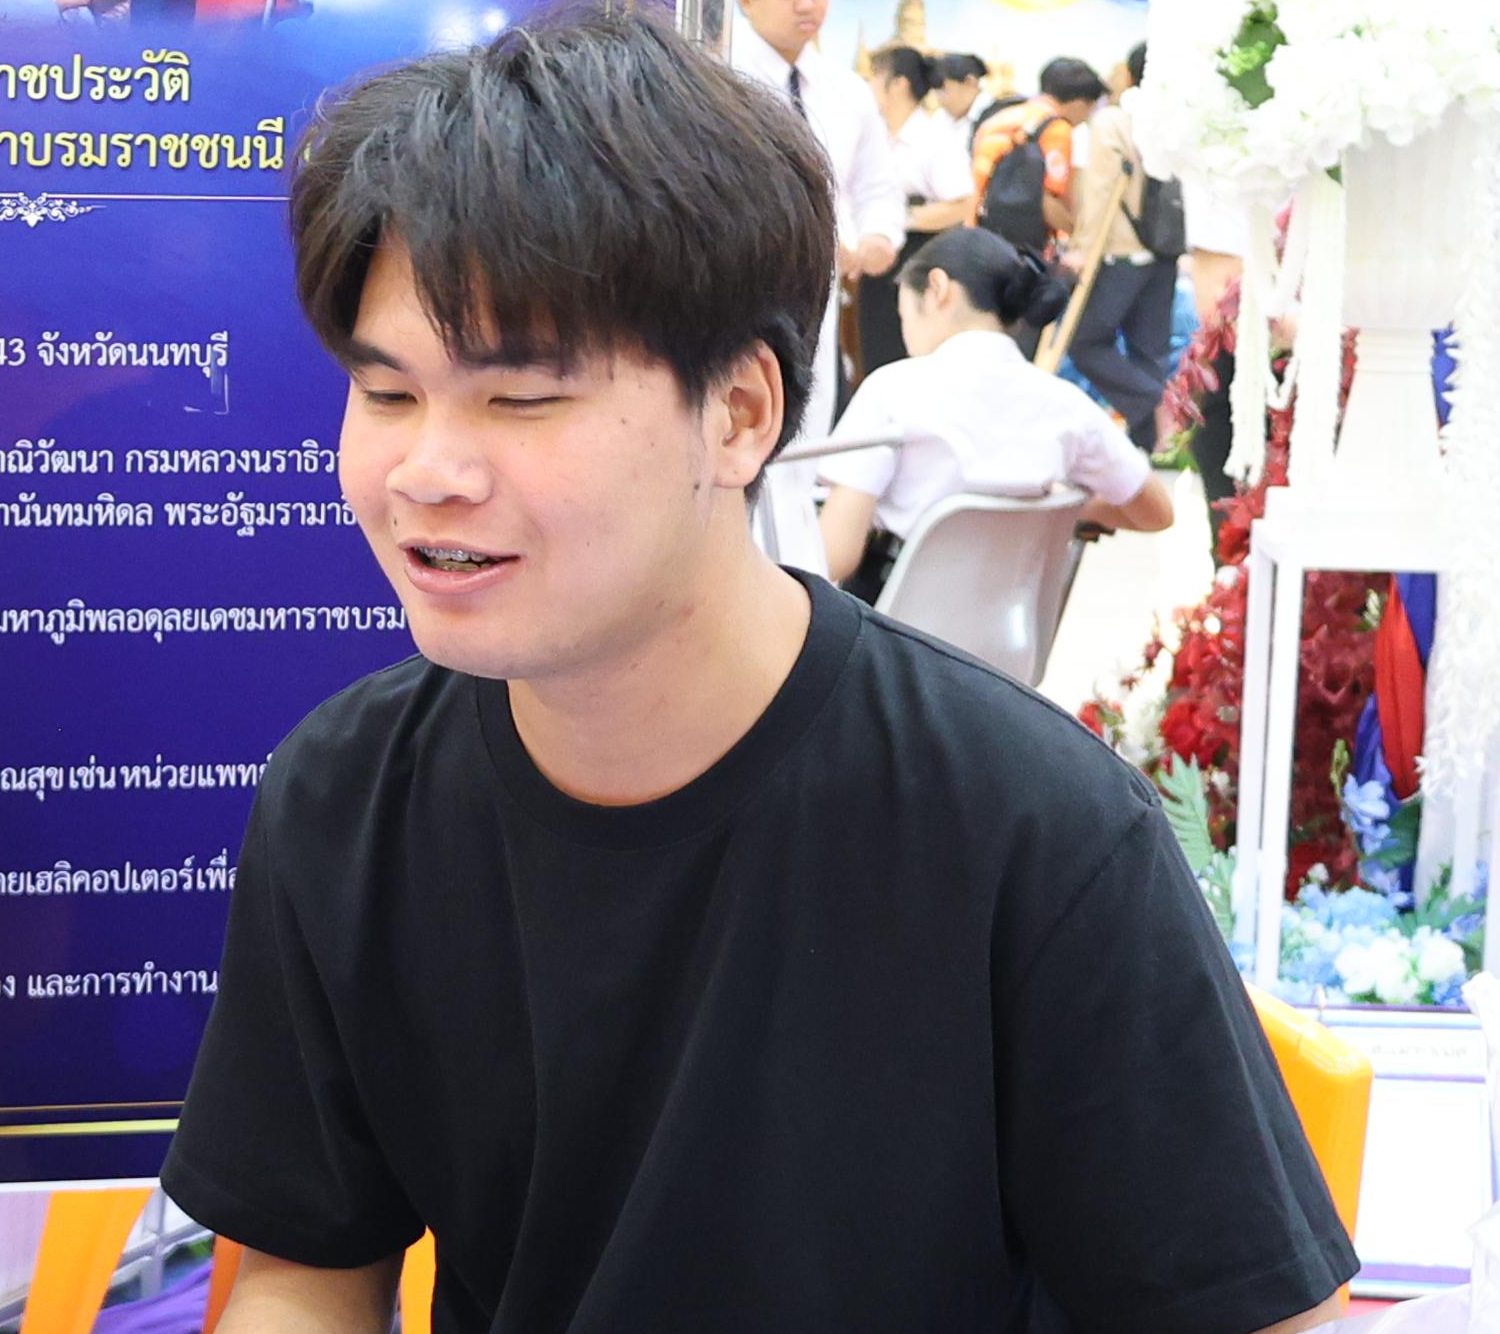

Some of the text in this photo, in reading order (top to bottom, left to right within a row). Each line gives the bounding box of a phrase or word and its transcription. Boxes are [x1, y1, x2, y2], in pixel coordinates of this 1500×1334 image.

[36, 330, 229, 379] จังหวัดนนทบุรี
[124, 438, 341, 474] กรมหลวงนราธิว
[163, 491, 357, 536] พระอัฐมรามาธ
[27, 961, 218, 997] และการทำงาน
